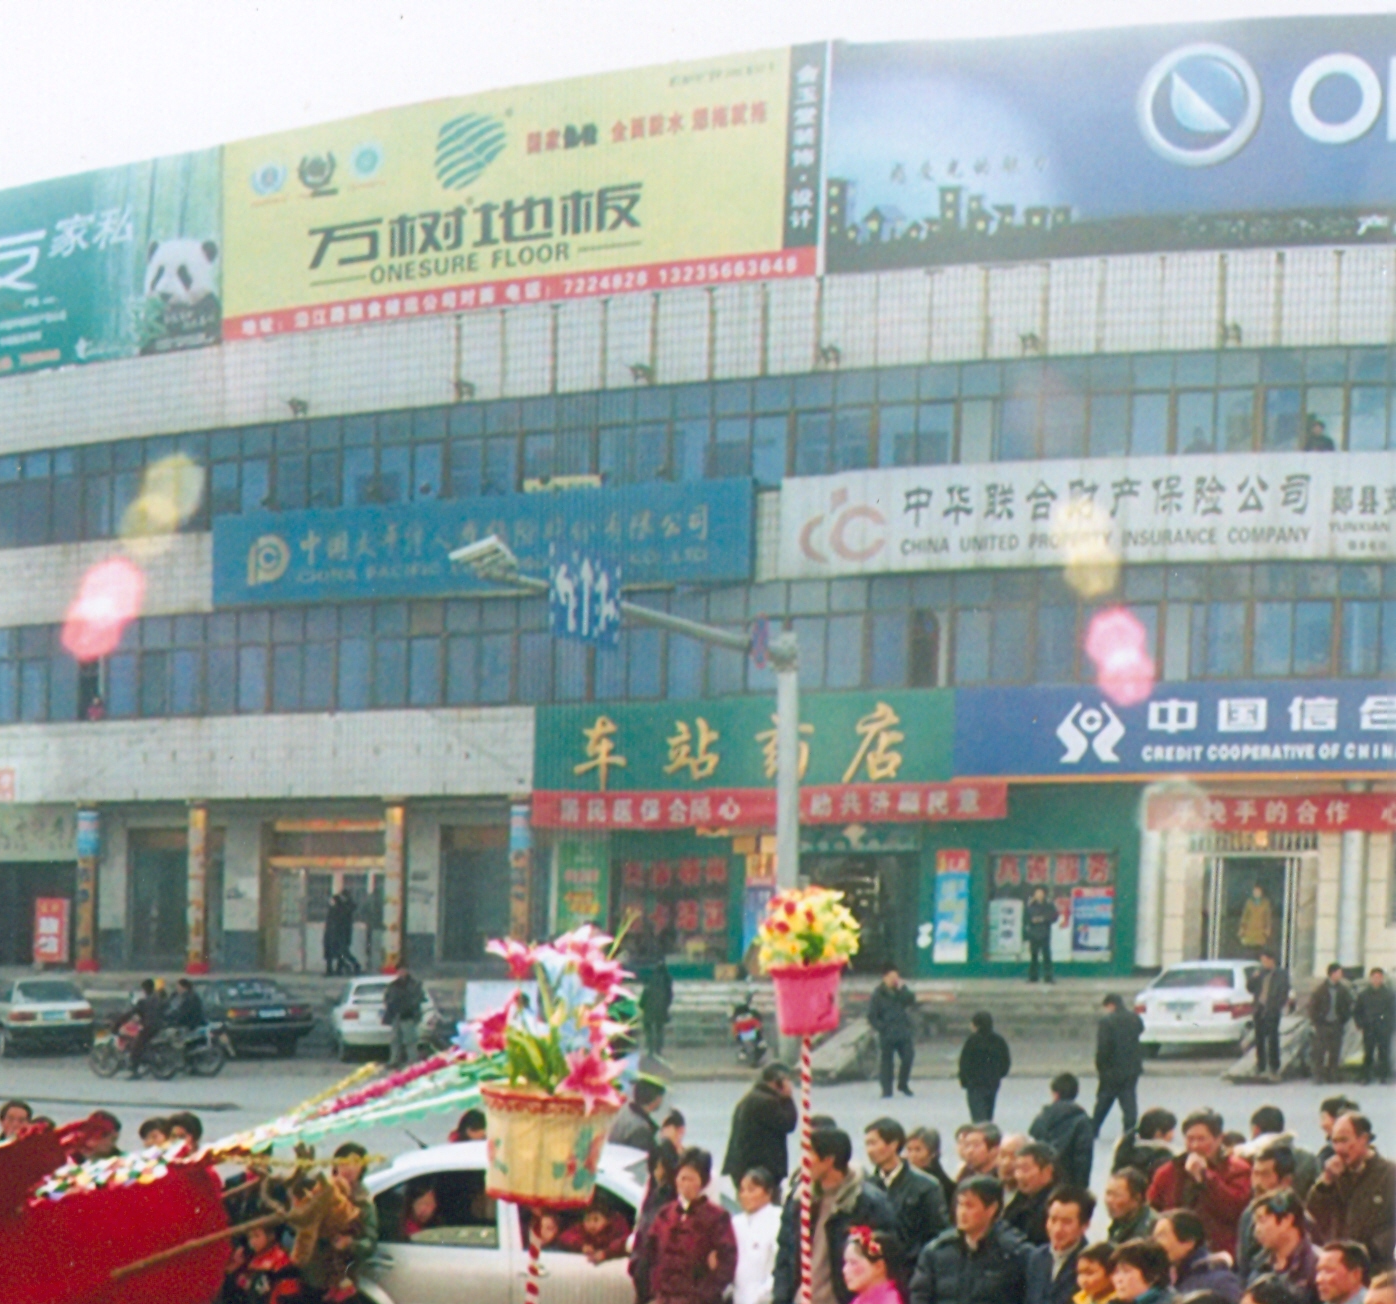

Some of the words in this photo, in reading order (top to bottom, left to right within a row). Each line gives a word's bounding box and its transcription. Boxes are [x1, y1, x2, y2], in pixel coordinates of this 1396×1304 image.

[48, 208, 134, 259] 家私
[308, 181, 644, 270] 万树地板
[369, 252, 480, 285] ONESURE
[492, 242, 571, 270] FLOOR
[902, 472, 1313, 528] 中华联合财产保险公司
[900, 537, 951, 556] CHINA
[960, 534, 1019, 553] UNITED
[1122, 526, 1217, 549] INSURANCE
[1226, 525, 1312, 545] COMPANY
[1141, 745, 1204, 762] CREDIT
[1208, 744, 1314, 761] COOPERATIVE
[1318, 743, 1340, 760] OF
[1344, 742, 1396, 760] CHIN
